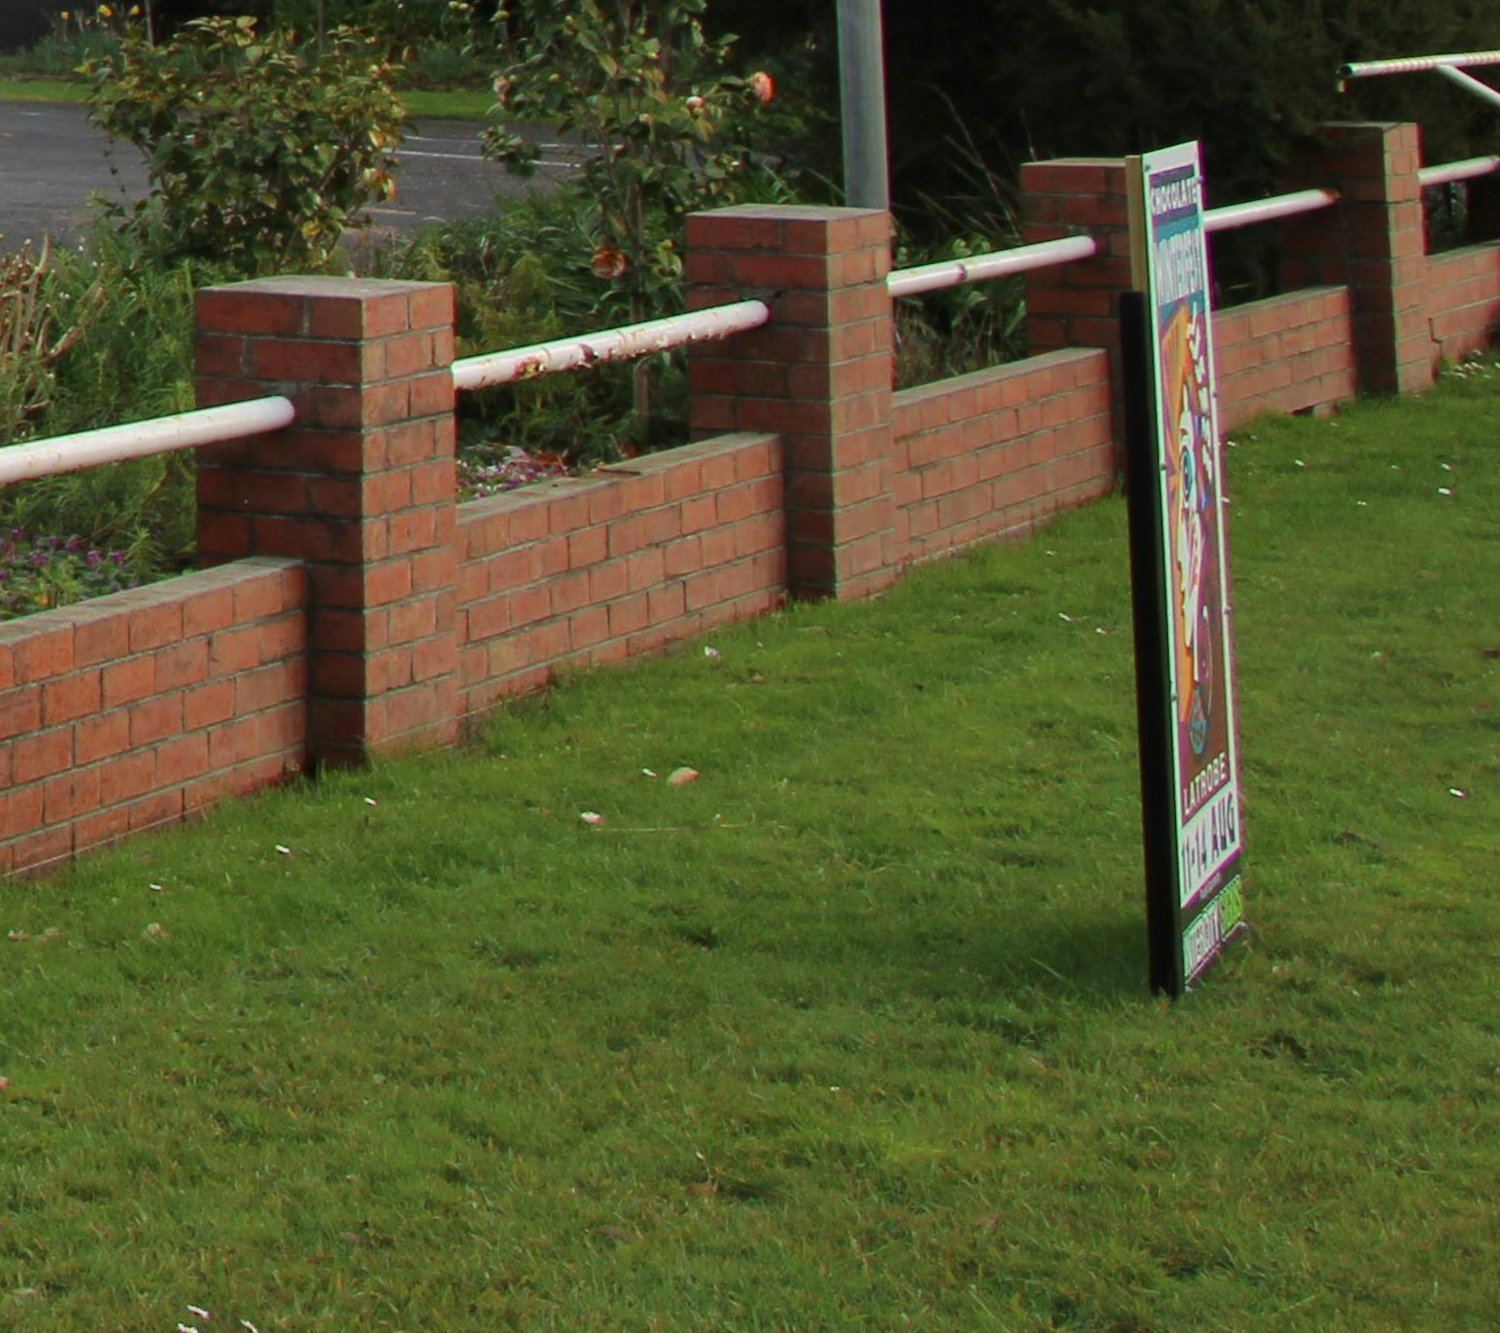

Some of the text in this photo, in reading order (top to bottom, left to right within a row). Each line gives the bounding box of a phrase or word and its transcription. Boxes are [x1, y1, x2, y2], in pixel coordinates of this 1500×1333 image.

[1151, 176, 1198, 215] CHOCOLATE
[1182, 751, 1227, 817] LATROBE
[1211, 790, 1236, 864] AUG
